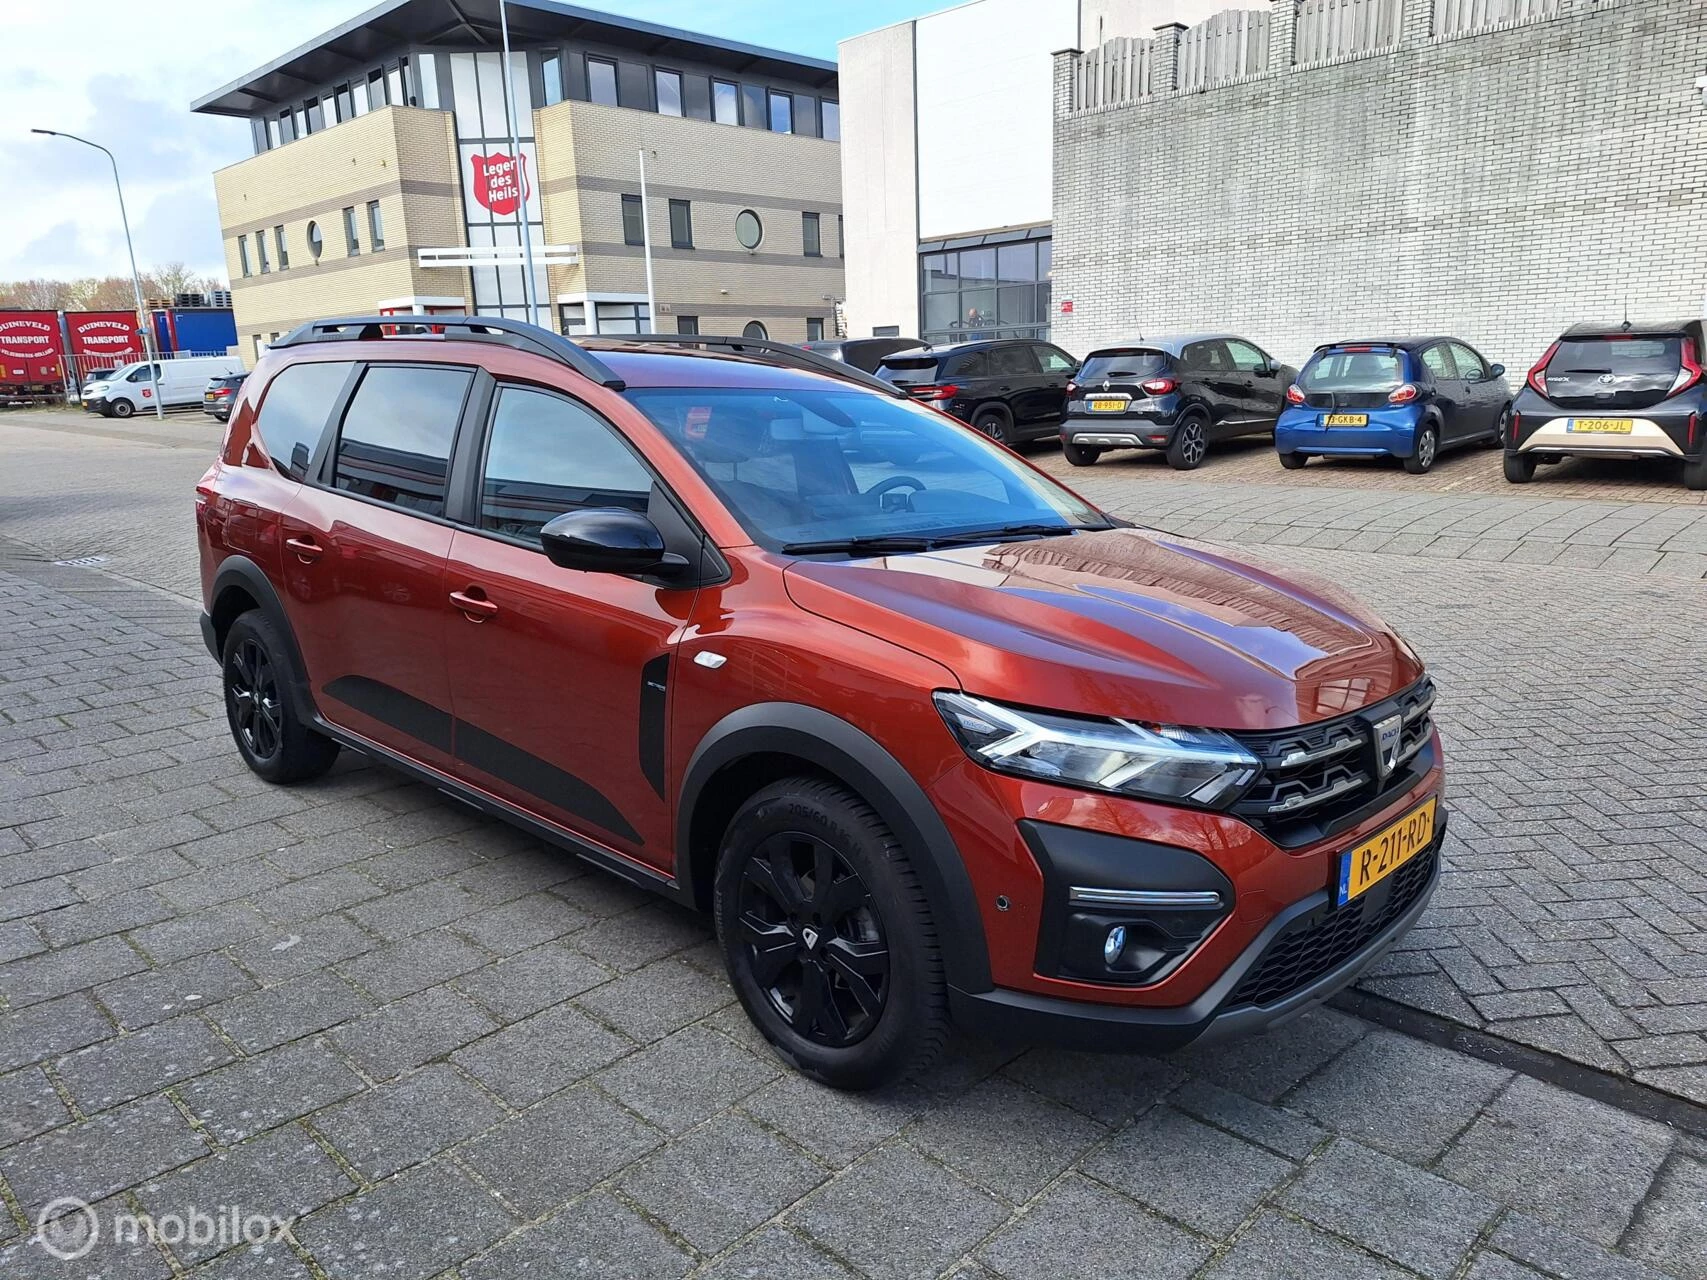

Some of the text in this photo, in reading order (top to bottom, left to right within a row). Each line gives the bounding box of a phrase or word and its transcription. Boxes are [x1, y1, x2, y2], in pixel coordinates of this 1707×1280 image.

[483, 160, 515, 176] Leger
[490, 175, 511, 188] des
[488, 187, 518, 202] Heils
[77, 321, 130, 333] DUINEVELD
[0, 335, 50, 345] TRANSPORT
[81, 335, 129, 345] TRANSPORT
[1327, 415, 1363, 424] 3-GKB-4
[1577, 420, 1626, 430] T-206-JL
[1359, 811, 1426, 886] R-211-RD
[1339, 883, 1348, 897] NL
